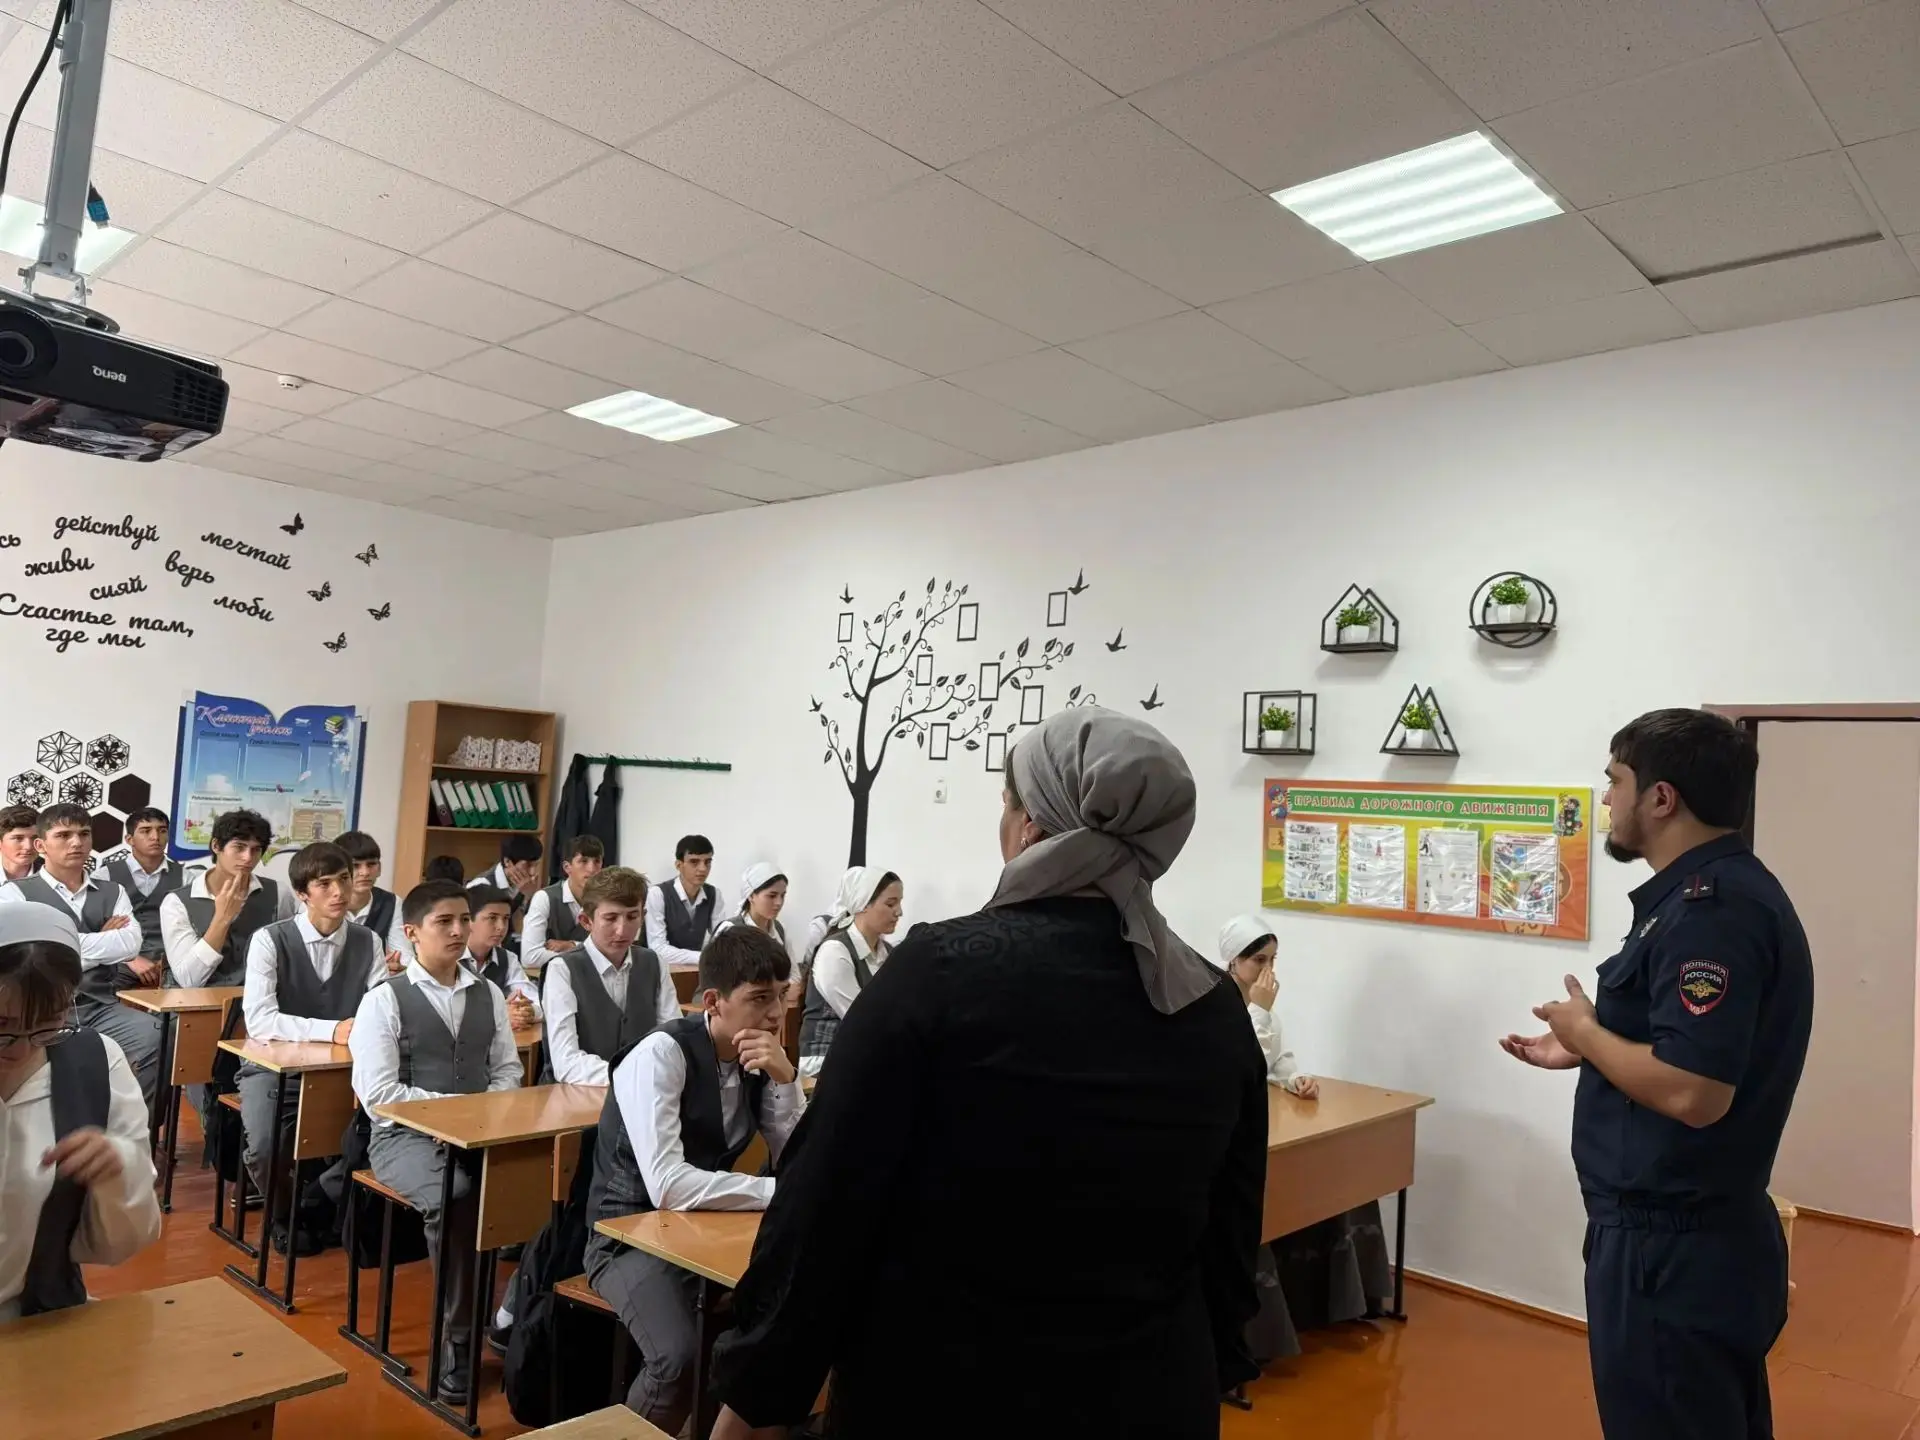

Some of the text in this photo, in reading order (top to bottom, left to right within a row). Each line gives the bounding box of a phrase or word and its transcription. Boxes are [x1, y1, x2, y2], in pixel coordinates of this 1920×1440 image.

[91, 364, 127, 383] BenQ
[53, 514, 160, 550] действуй
[24, 547, 95, 577] живи
[200, 532, 292, 571] мечтай
[164, 549, 215, 588] верь
[89, 575, 148, 601] сияй
[0, 592, 194, 638] Счастье там,
[213, 596, 275, 622] люби
[45, 628, 146, 653] где мы
[1294, 795, 1549, 817] ПРАВИЛА ДОРОЖНОГО ДВИЖЕНИЯ
[1682, 961, 1727, 976] ПОЛИЦИЯ
[1684, 971, 1723, 985] РОССИЯ
